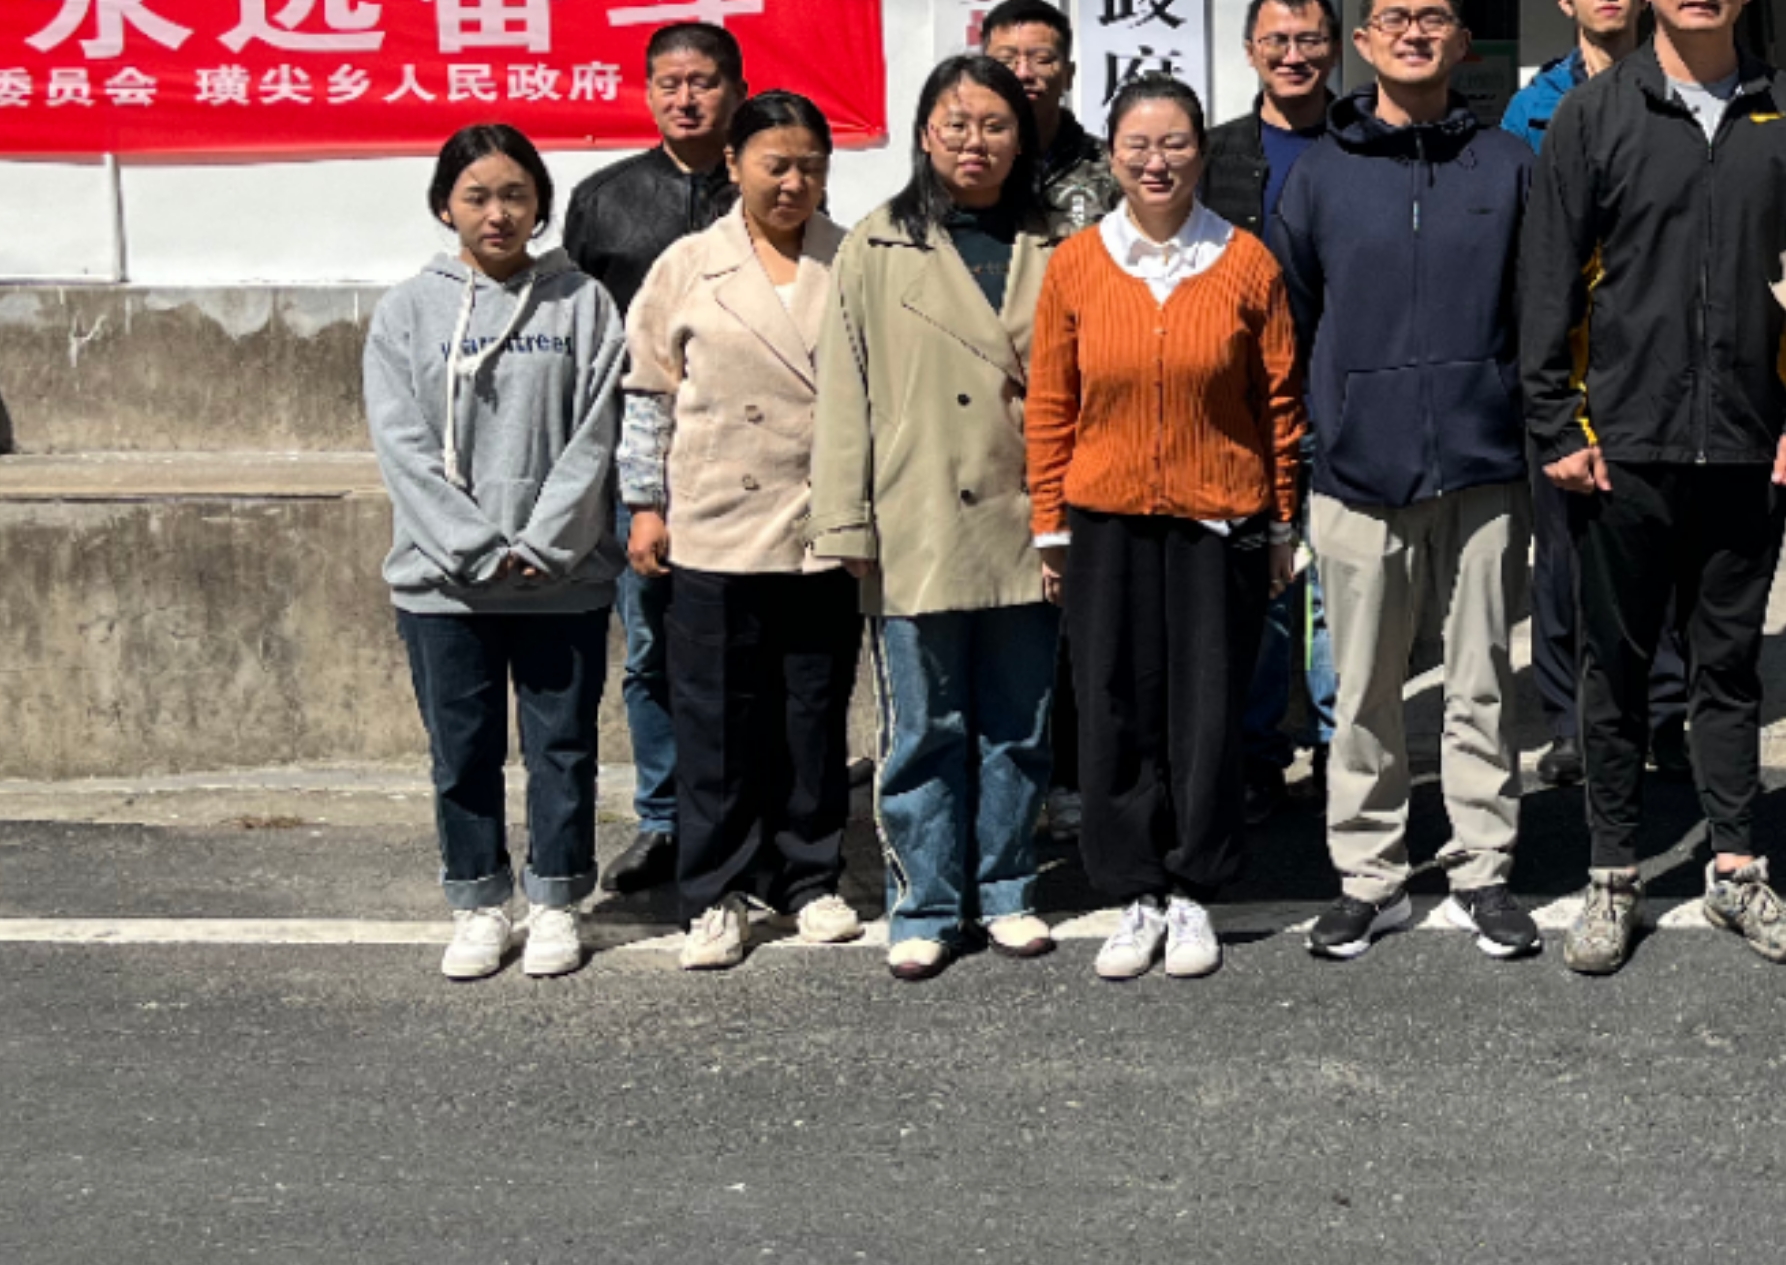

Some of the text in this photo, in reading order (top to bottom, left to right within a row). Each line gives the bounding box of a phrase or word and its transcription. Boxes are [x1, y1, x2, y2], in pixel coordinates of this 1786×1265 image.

[195, 61, 624, 107] 璜尖乡人民政府
